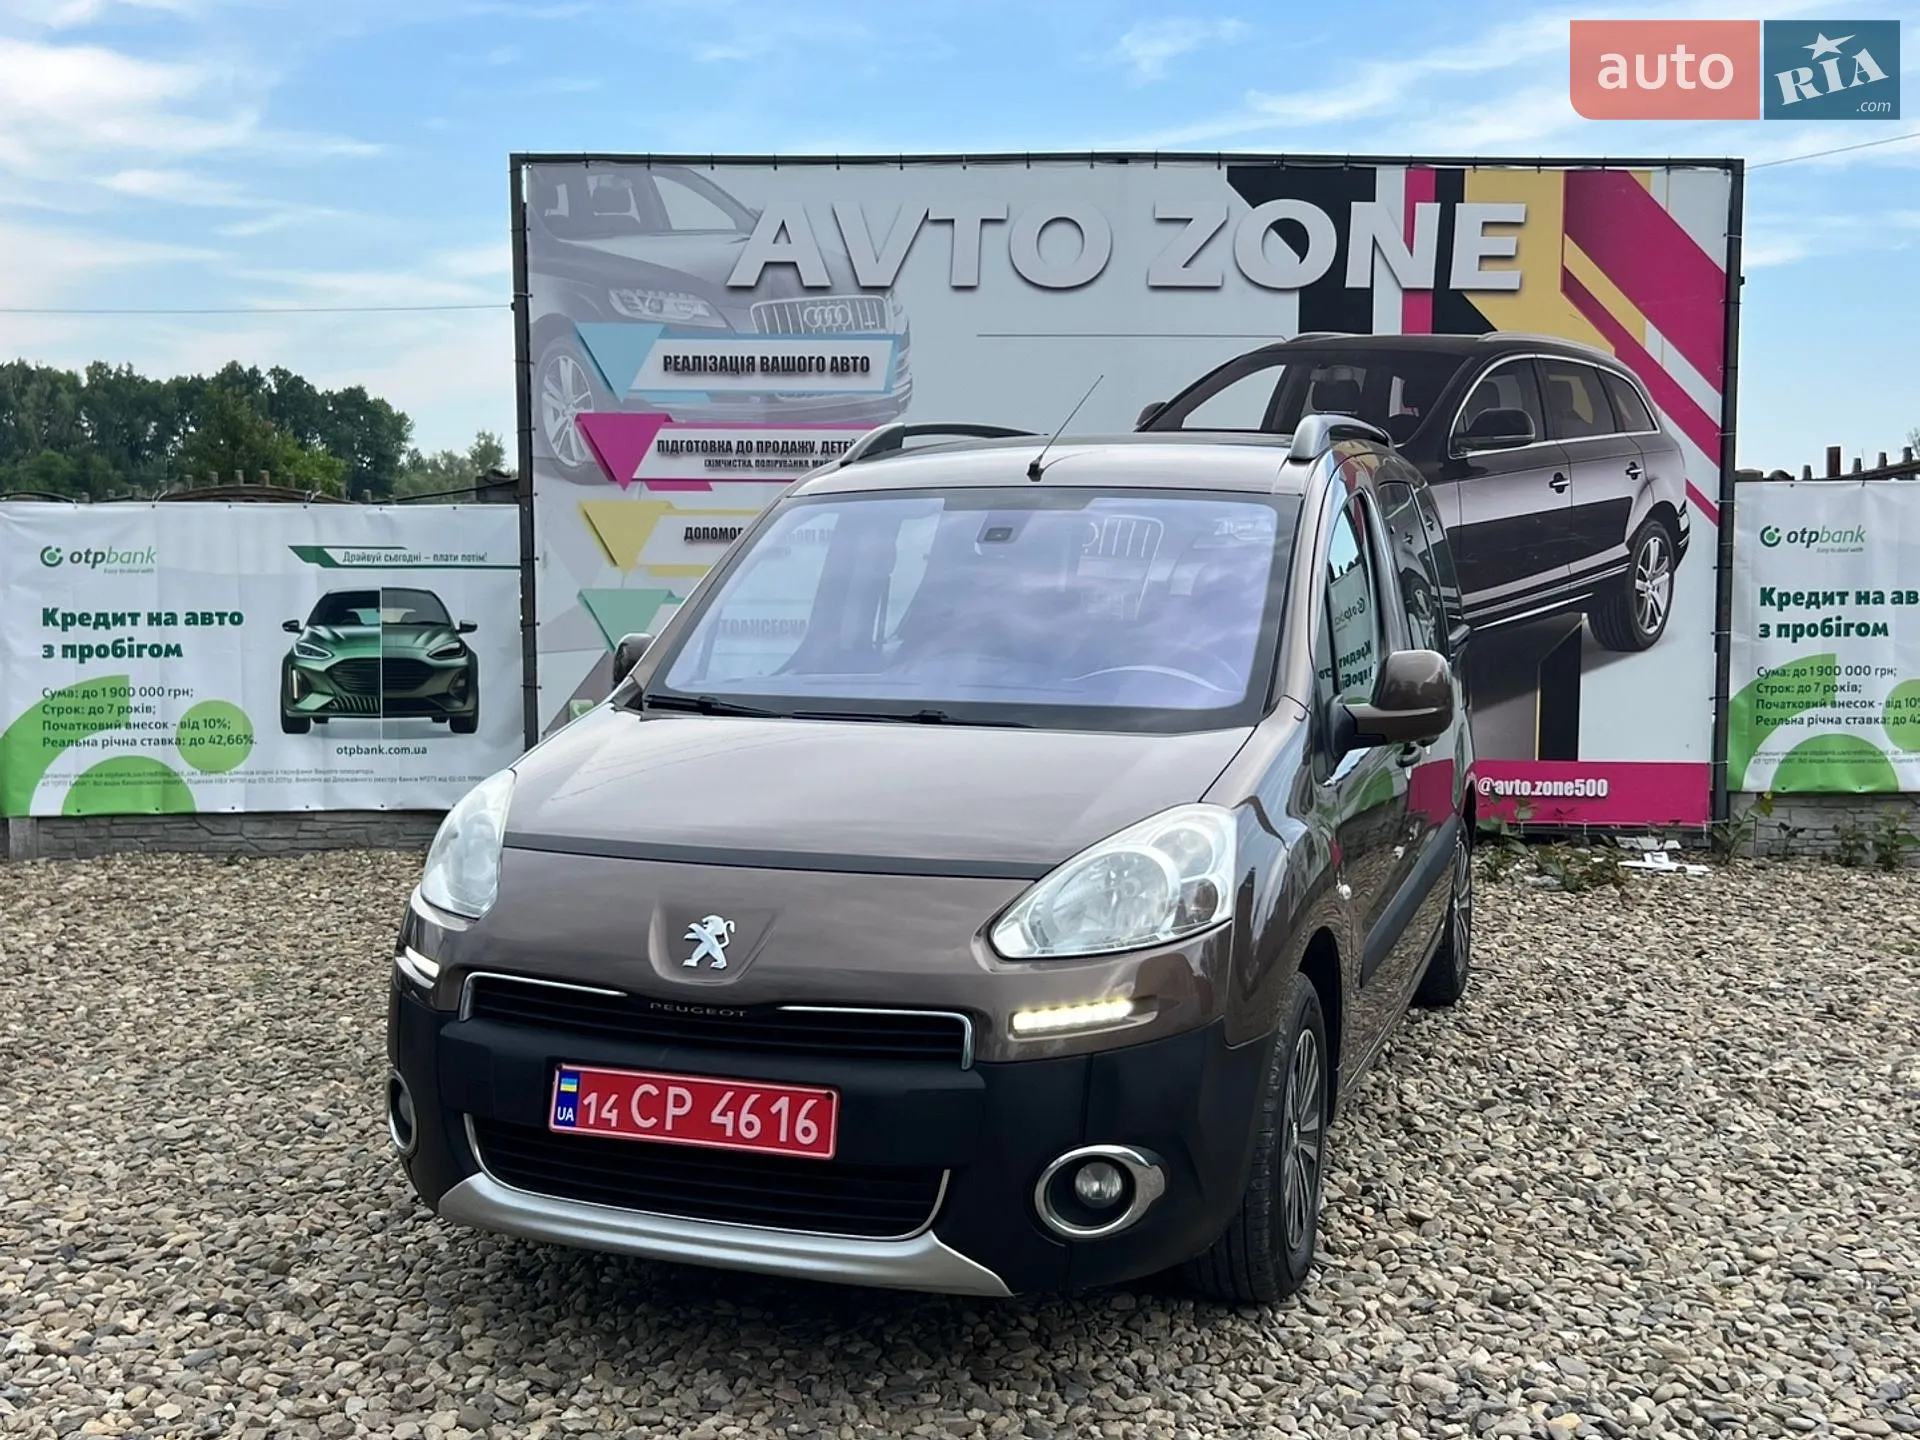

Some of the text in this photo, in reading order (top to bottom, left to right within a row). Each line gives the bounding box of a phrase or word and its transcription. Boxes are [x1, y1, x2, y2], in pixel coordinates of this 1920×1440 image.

[726, 198, 1527, 291] AVTO ZONE
[663, 356, 870, 375] РЕАЛІЗАЦІЯ ВАШОГО АВТО
[657, 438, 856, 455] ПІДГОТОВКА ДО ПРОДАЖУ, ДЕТЕ
[684, 526, 743, 541] ДОПОМОГ
[1786, 525, 1866, 548] otpbank
[69, 546, 157, 569] otpbank
[343, 551, 381, 564] Драйвуй
[384, 552, 421, 563] сьогодні
[433, 552, 458, 562] плати
[461, 552, 488, 562] потім!
[1760, 587, 1920, 611] Кредит на ав
[42, 607, 244, 632] Кредит на авто
[1759, 615, 1889, 643] з пробігом
[42, 636, 183, 664] з пробігом
[1757, 667, 1790, 679] Сума:
[1792, 667, 1806, 679] до
[1875, 666, 1897, 678] грн;
[42, 687, 78, 700] Сума:
[82, 689, 98, 700] до
[168, 688, 194, 700] грн;
[1756, 682, 1862, 695] Строк: до 7 років;
[42, 703, 156, 718] Строк: до 7 років;
[1756, 699, 1826, 710] Початковий
[1830, 699, 1874, 709] внесок
[1885, 698, 1901, 709] від
[42, 719, 122, 731] Початковий
[125, 721, 168, 730] внесок
[180, 719, 199, 731] від
[203, 718, 231, 731] 10%;
[1756, 715, 1804, 726] Реальна
[1807, 714, 1842, 727] річна
[1845, 716, 1890, 725] ставка:
[1892, 716, 1906, 726] до
[42, 734, 257, 750] Реальна річна ставка: до 42,66%.
[336, 744, 427, 757] otpbank.com.ua
[1478, 777, 1608, 797] @avto.zone500
[650, 1002, 748, 1017] PEUGEOT
[557, 1106, 574, 1121] UA
[582, 1083, 818, 1145] 14 CP 4616
